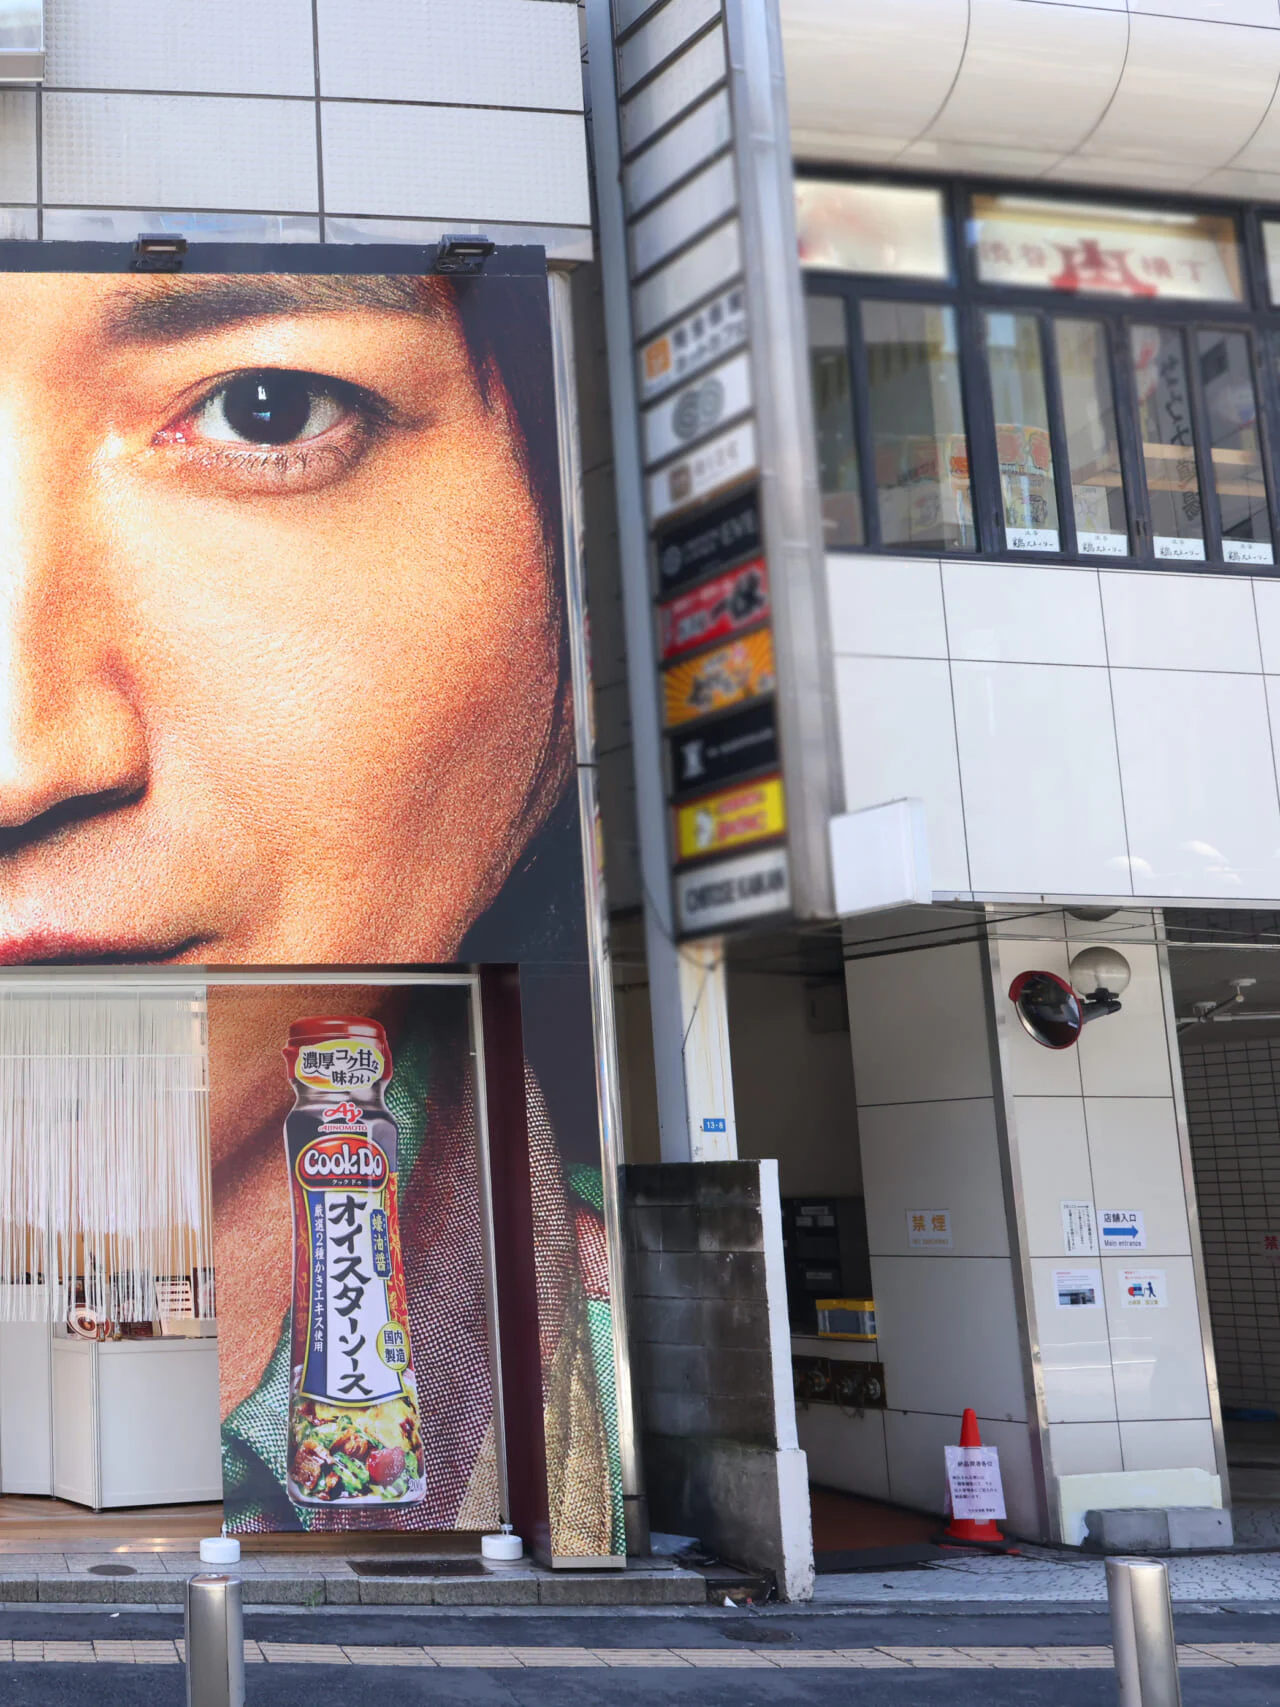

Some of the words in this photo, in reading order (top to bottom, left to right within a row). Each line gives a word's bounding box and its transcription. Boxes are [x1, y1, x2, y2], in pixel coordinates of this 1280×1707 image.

[331, 1071, 371, 1085] 味わい
[318, 1124, 368, 1132] AJINOMOTO
[1103, 1213, 1137, 1223] 店舗入口
[1104, 1239, 1117, 1247] Main
[328, 1194, 373, 1396] オイスターソース
[384, 1330, 404, 1345] 国内
[384, 1348, 406, 1363] 製造
